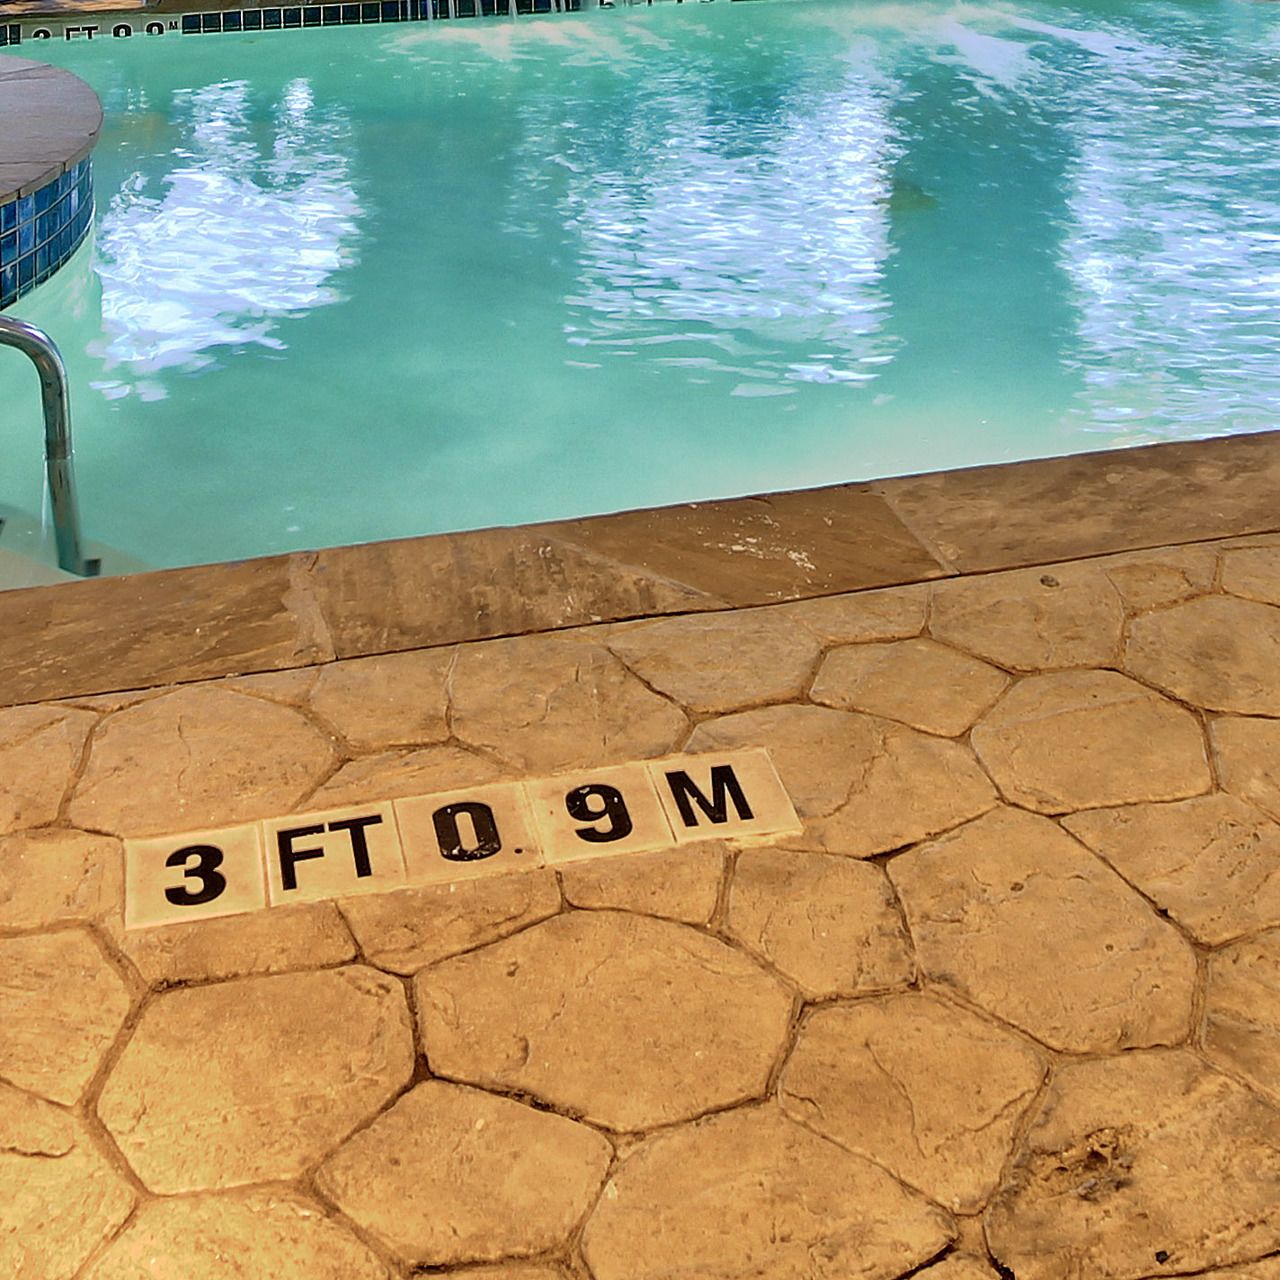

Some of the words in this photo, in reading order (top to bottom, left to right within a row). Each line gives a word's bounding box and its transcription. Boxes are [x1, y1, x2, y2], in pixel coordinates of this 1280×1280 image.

[164, 844, 226, 907] 3
[276, 815, 383, 891] FT
[663, 764, 754, 828] M
